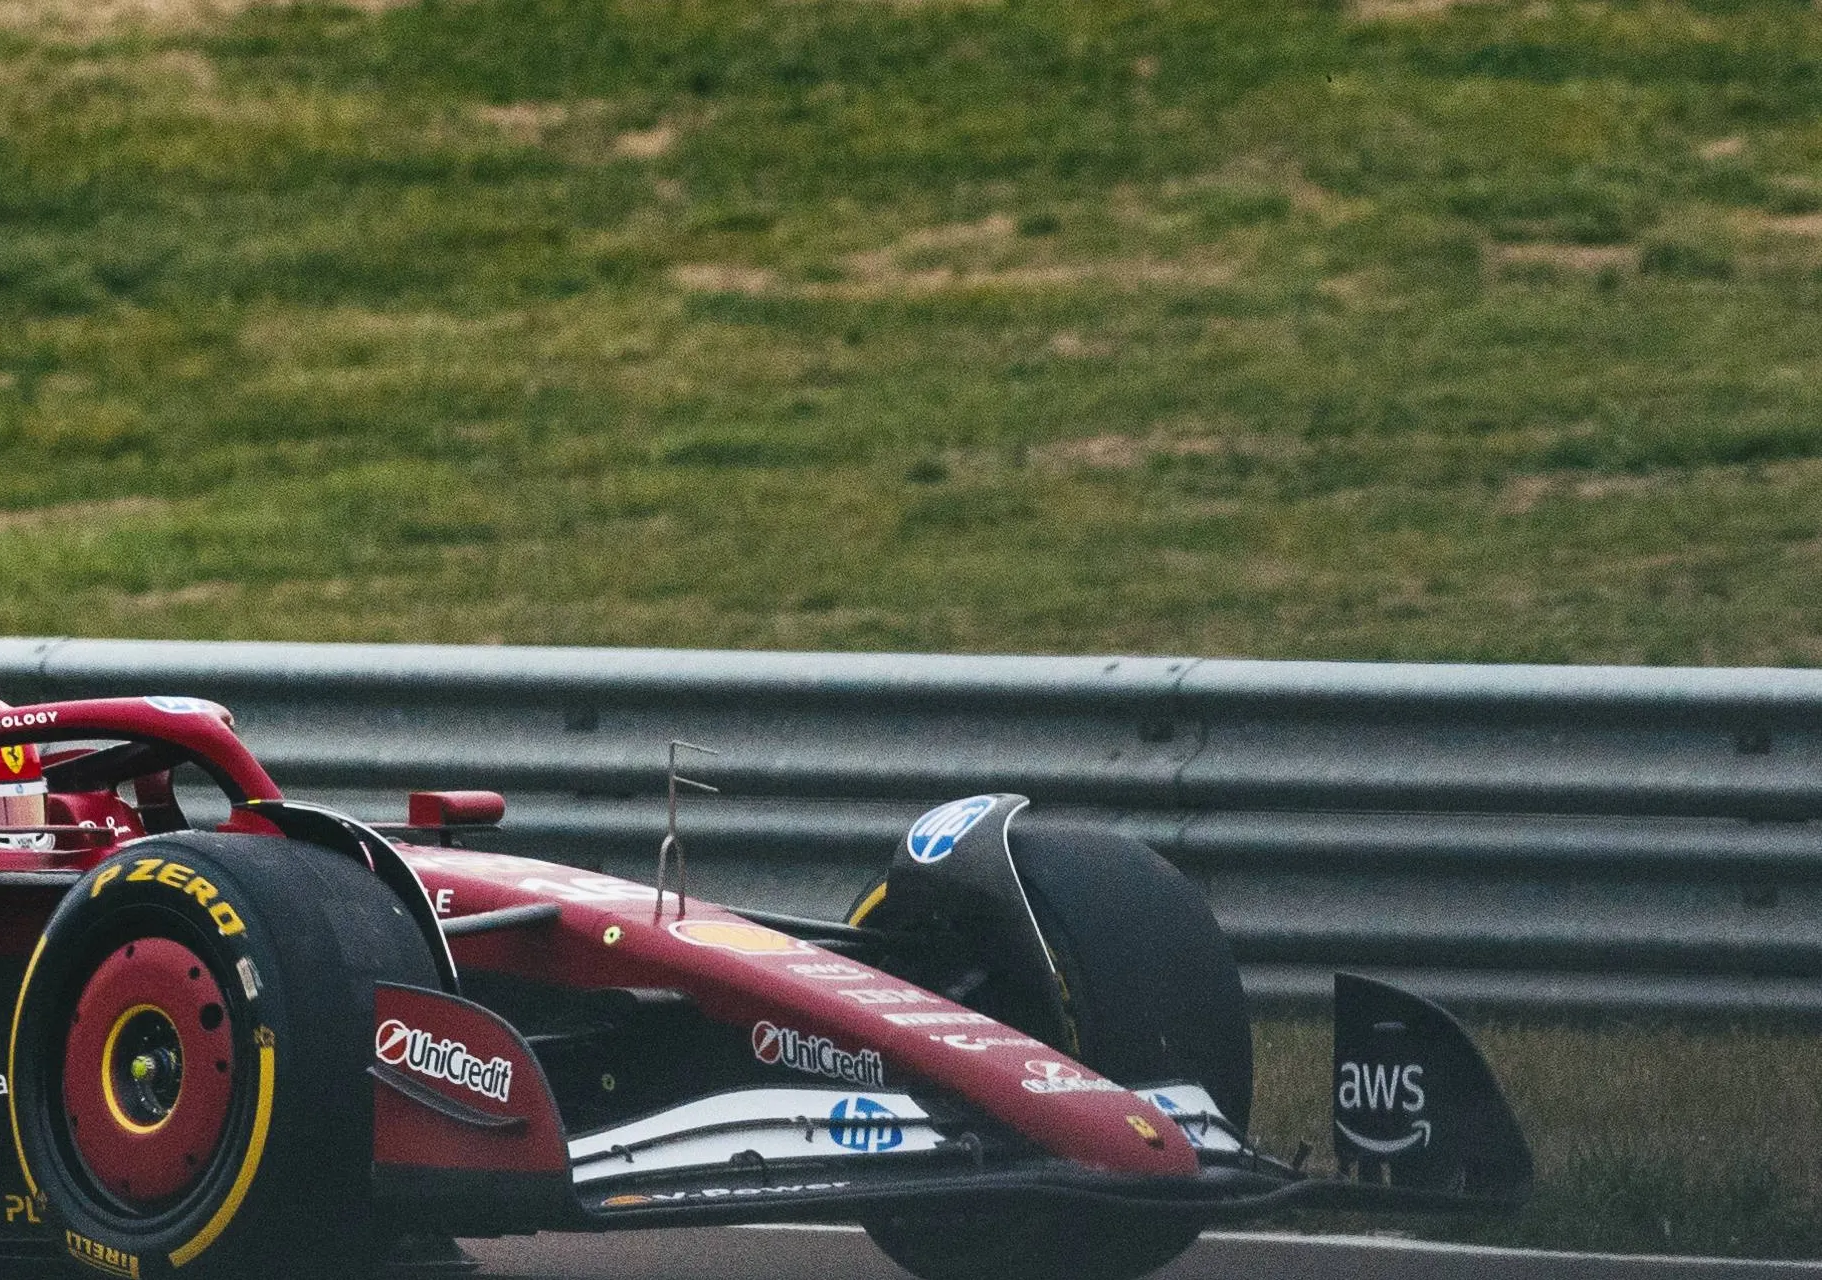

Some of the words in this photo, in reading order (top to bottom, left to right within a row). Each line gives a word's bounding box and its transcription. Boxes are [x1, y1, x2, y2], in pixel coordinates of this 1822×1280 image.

[90, 864, 122, 899] P
[125, 858, 247, 938] ZERO
[406, 1031, 512, 1102] UniCredit
[777, 1029, 885, 1087] UniCredit
[1338, 1061, 1426, 1112] aws
[4, 1194, 42, 1225] PL
